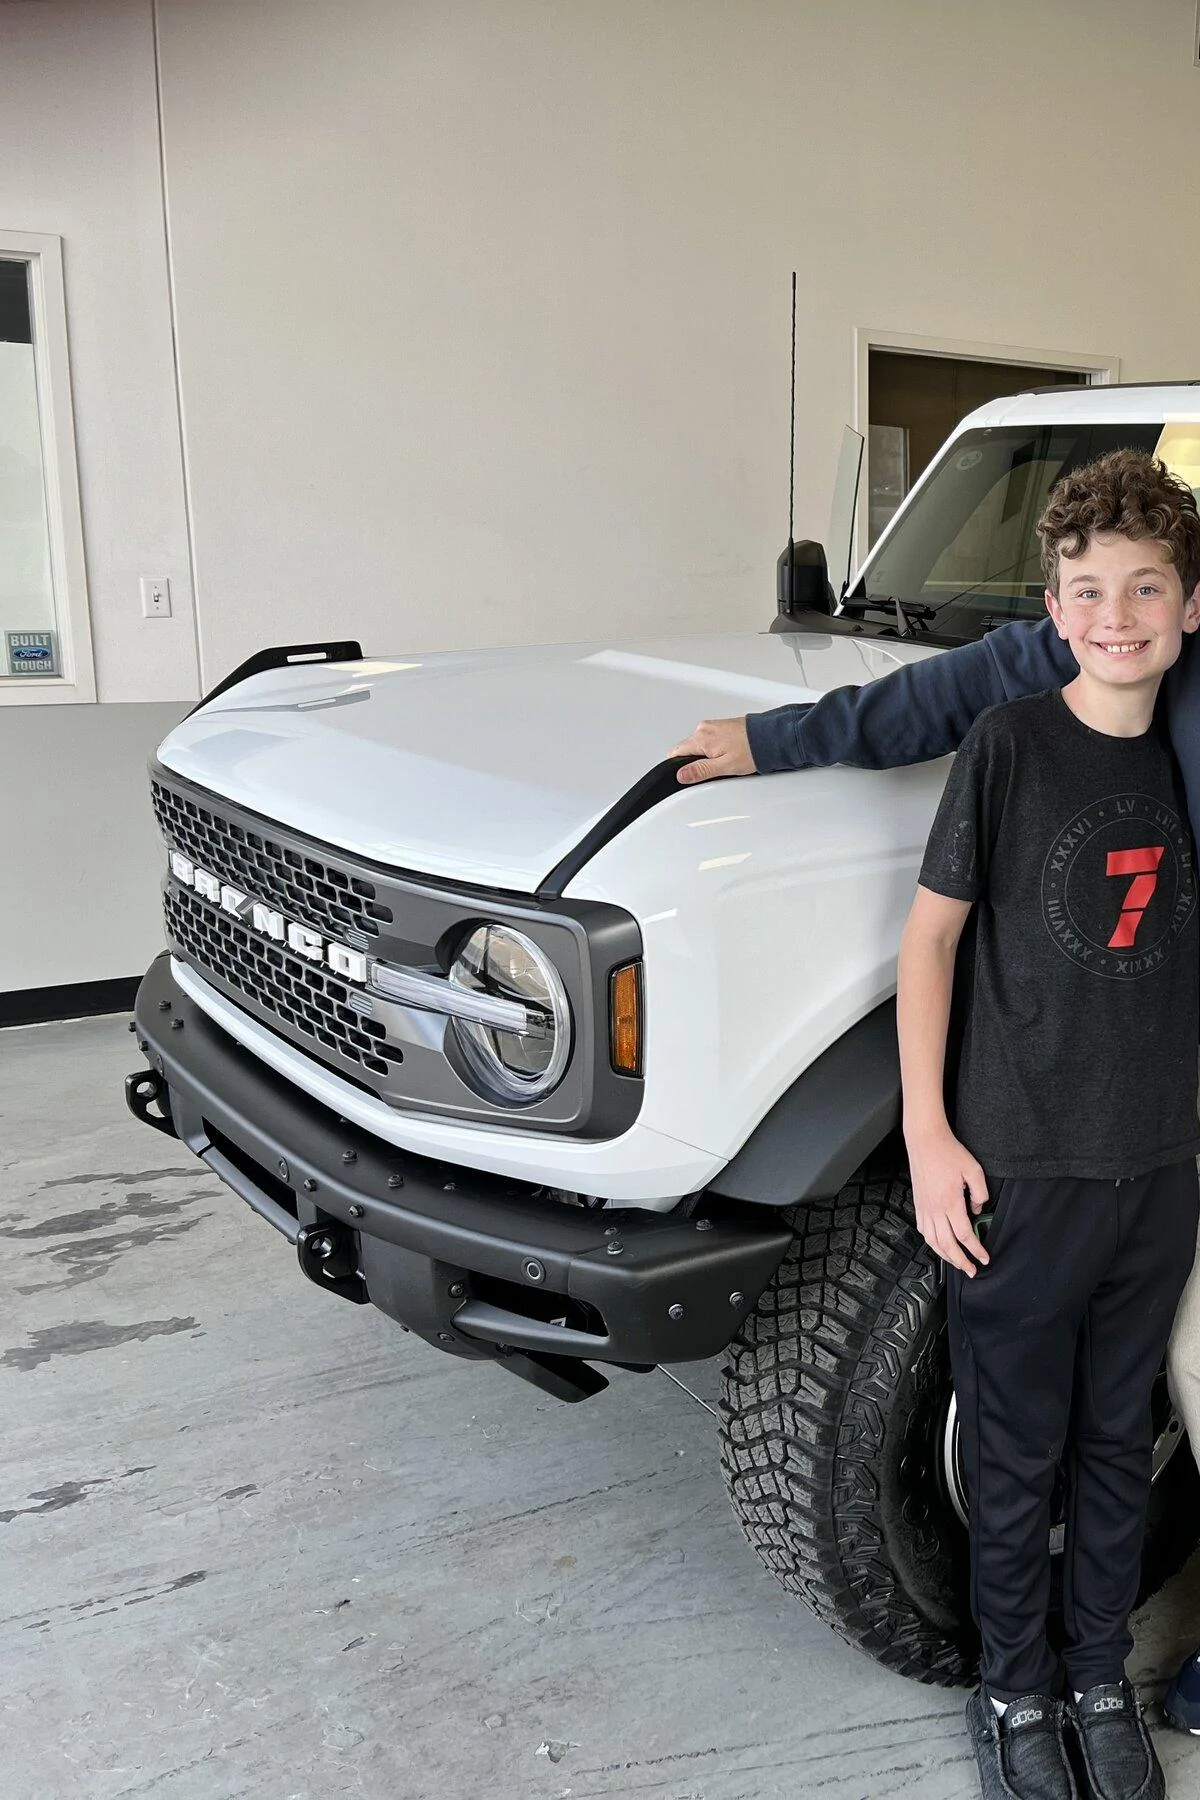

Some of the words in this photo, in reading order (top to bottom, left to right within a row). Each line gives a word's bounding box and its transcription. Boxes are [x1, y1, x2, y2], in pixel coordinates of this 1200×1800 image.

[10, 634, 49, 646] BUILT
[13, 660, 52, 671] TOUGH
[1116, 800, 1136, 814] LV
[1051, 817, 1093, 873] XXXVI
[171, 851, 367, 983] BRONCO
[1106, 846, 1165, 948] 7
[1171, 891, 1192, 932] XLIX
[1047, 899, 1093, 962] XXXVIII
[1116, 946, 1164, 975] XXXIX
